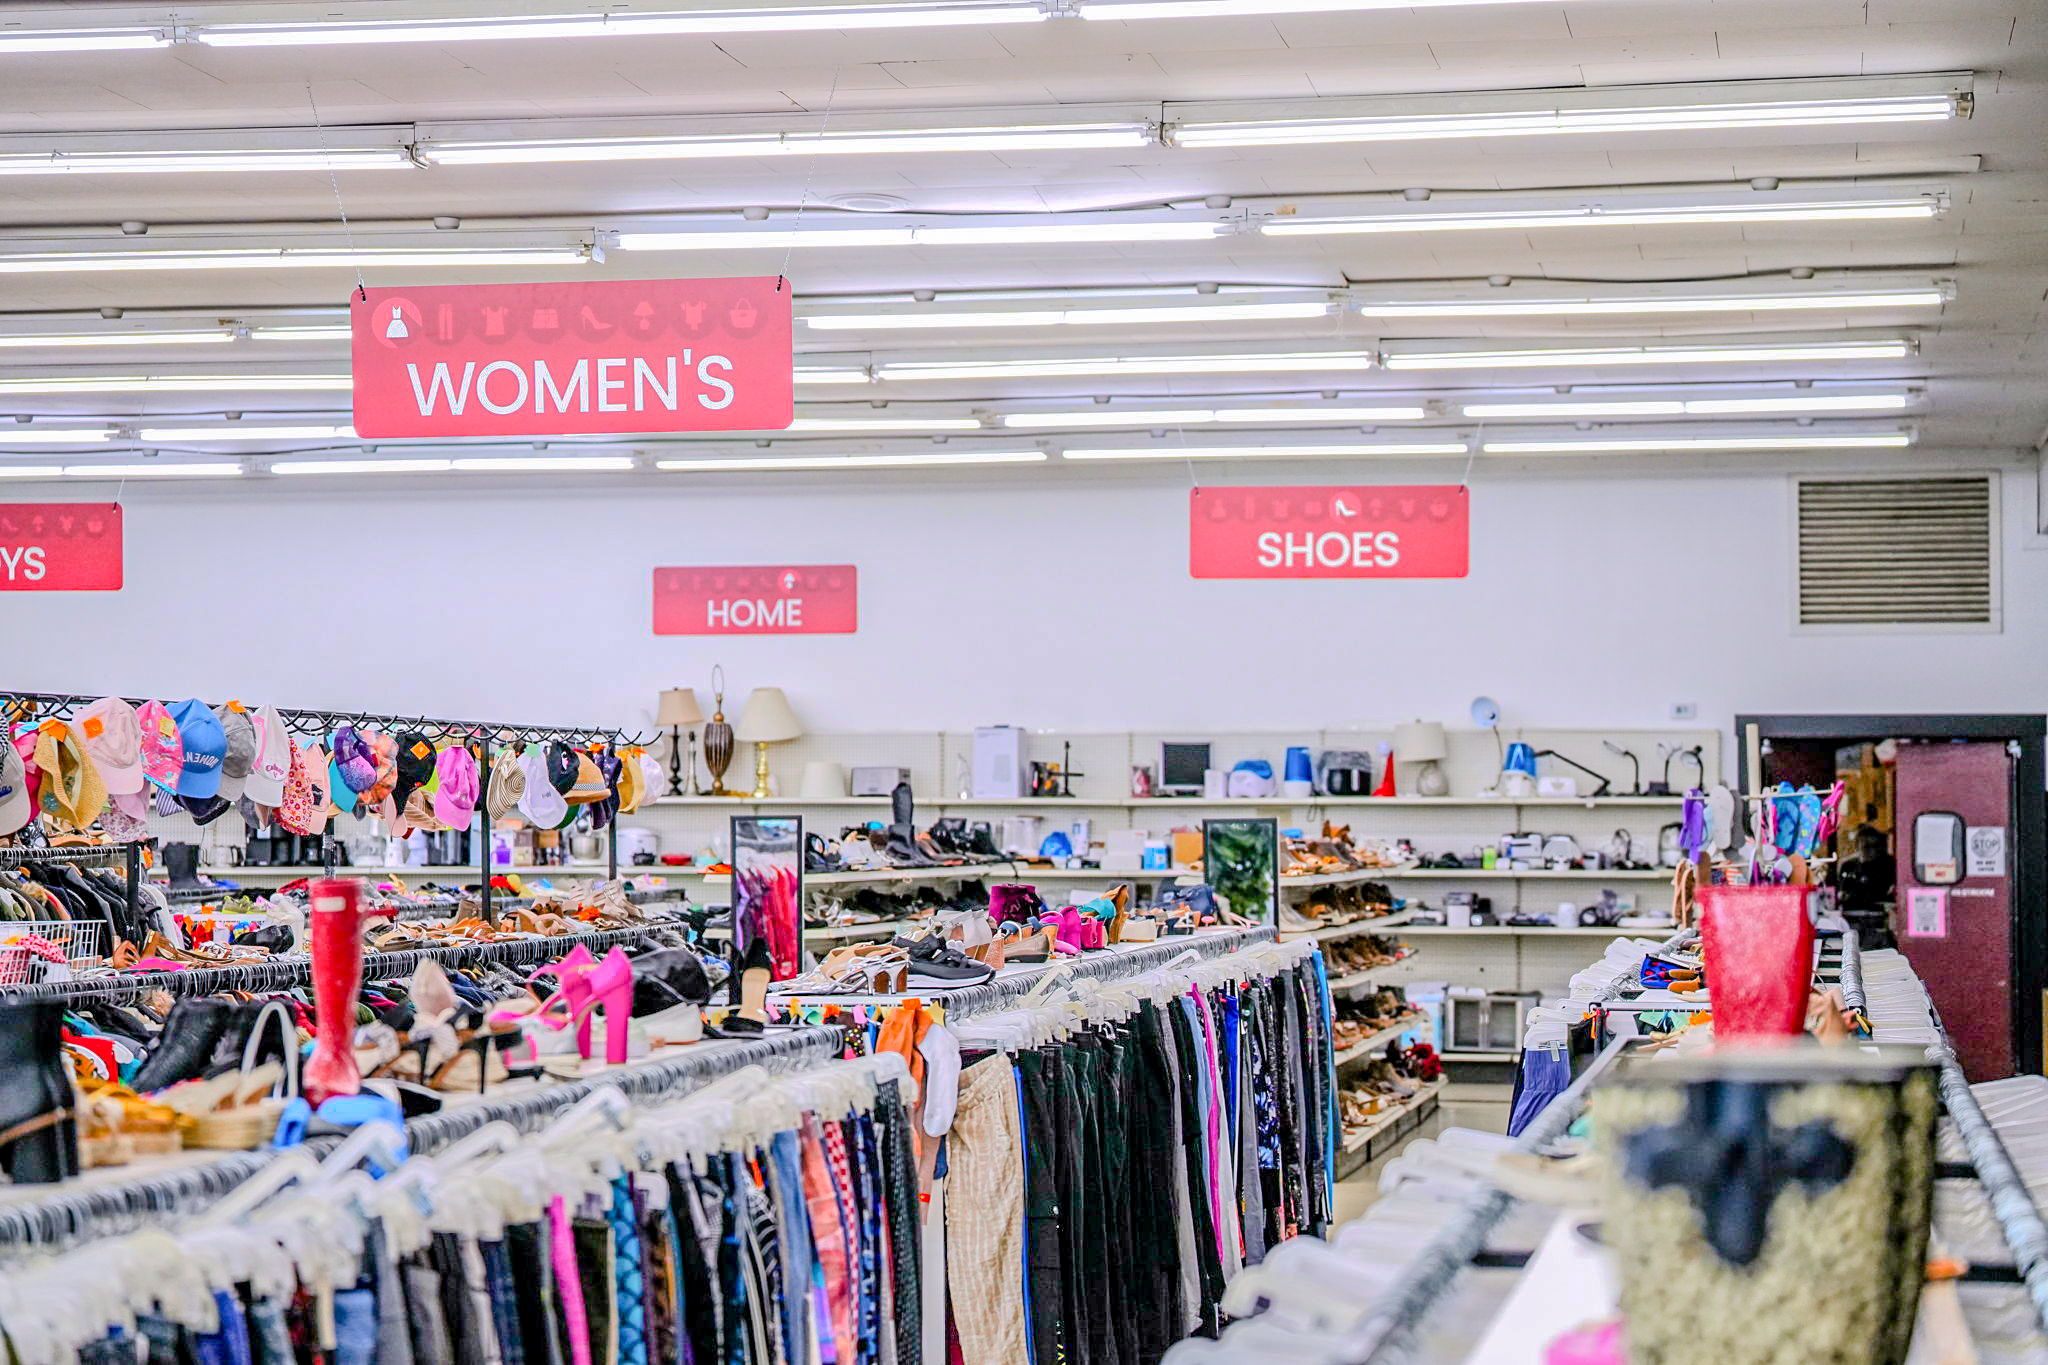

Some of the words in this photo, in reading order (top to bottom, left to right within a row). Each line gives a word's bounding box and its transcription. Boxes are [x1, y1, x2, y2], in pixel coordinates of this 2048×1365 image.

[406, 348, 735, 416] WOMEN'S
[0, 546, 46, 581] YS
[1257, 531, 1400, 568] SHOES
[706, 598, 803, 627] HOME
[1974, 839, 1998, 849] STOP
